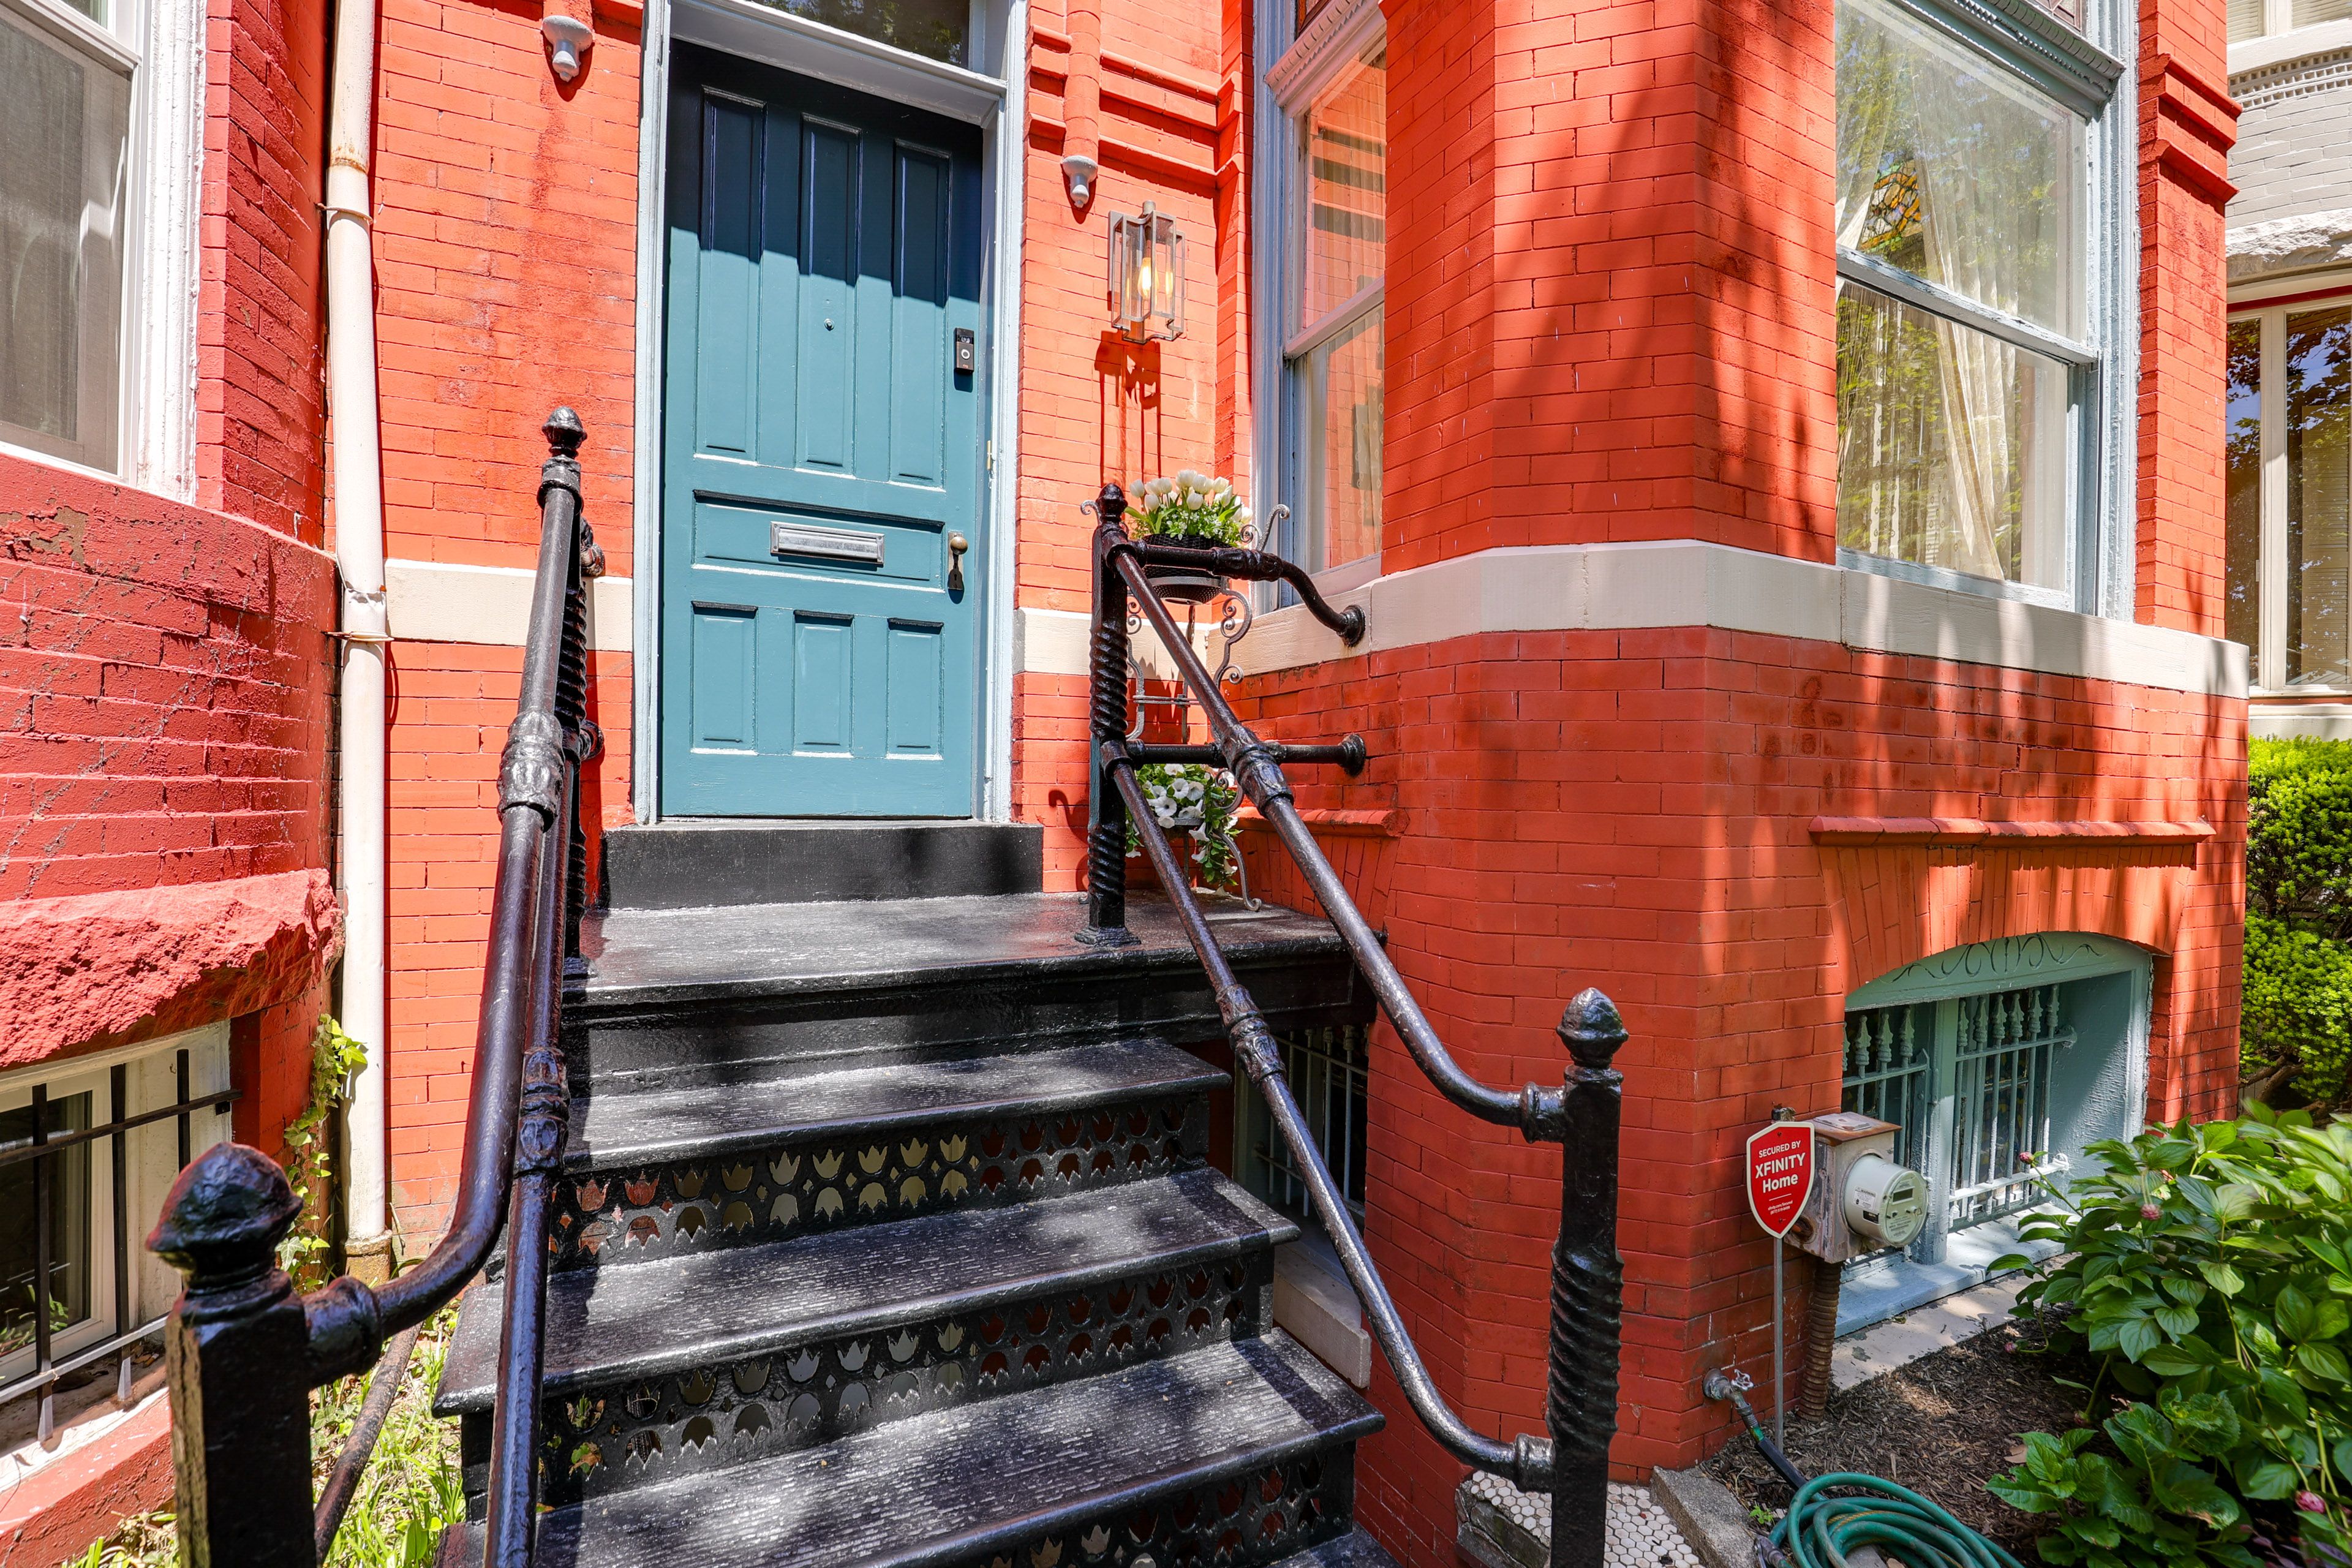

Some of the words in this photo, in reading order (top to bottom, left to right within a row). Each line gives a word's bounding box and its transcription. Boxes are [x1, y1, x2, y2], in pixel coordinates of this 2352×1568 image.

[1758, 1143, 1790, 1158] SECURED
[1792, 1140, 1801, 1149] BY
[1755, 1152, 1806, 1179] XFINITY
[1762, 1174, 1798, 1193] Home
